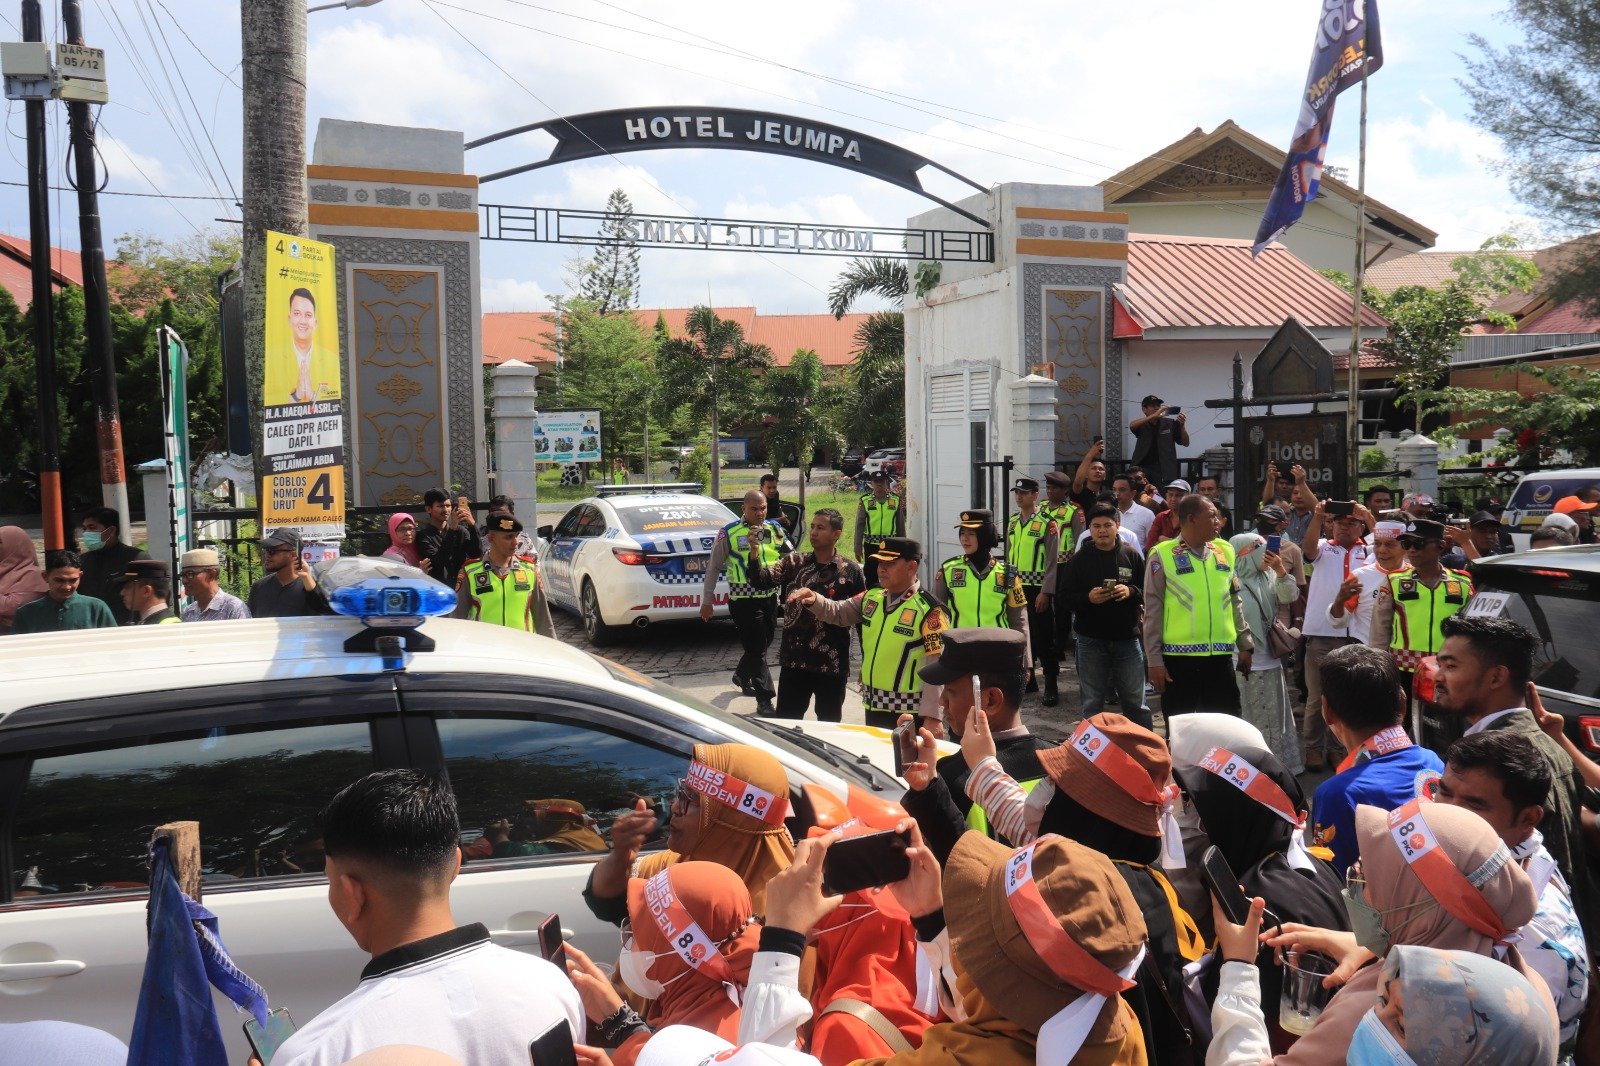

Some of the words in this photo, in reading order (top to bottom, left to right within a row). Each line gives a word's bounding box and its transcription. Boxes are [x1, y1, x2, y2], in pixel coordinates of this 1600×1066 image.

[61, 44, 104, 58] DAR-FR
[64, 57, 99, 69] 05/12
[625, 116, 733, 141] HOTEL
[746, 119, 862, 162] JEUMPA
[1291, 164, 1302, 204] NOMOR
[622, 217, 711, 246] SMKN
[726, 224, 741, 246] 5
[752, 225, 873, 252] TELKOM
[276, 240, 285, 254] 4
[302, 245, 322, 254] PARTAI
[302, 252, 324, 261] GOLKAR
[283, 404, 311, 417] HAEQAL
[267, 424, 294, 439] CALEG
[297, 422, 315, 435] DPR
[317, 419, 339, 432] ACEH
[289, 435, 313, 449] DAPIL
[317, 434, 321, 445] 1
[1267, 438, 1319, 461] Hotel
[273, 457, 312, 472] SULAIMAN
[314, 454, 335, 467] ABDA
[1257, 464, 1333, 484] Jpa
[273, 477, 307, 487] COBLOS
[273, 488, 304, 498] NOMOR
[307, 473, 334, 511] 4
[273, 500, 296, 510] URUT
[322, 515, 343, 523] CALEG
[660, 510, 701, 520] Z804
[643, 521, 677, 531] JANGAN
[653, 594, 700, 608] PATROLI
[1473, 597, 1503, 613] VVIP
[1078, 733, 1090, 746] 8
[1083, 746, 1094, 757] PKS
[1224, 762, 1236, 775] 8
[1231, 776, 1244, 787] PKS
[743, 794, 754, 808] 8
[751, 807, 763, 816] PKS
[1399, 821, 1415, 837] 8
[1401, 839, 1414, 856] PKS
[1014, 851, 1028, 866] 8
[678, 932, 694, 949] 8
[683, 951, 698, 964] PKS
